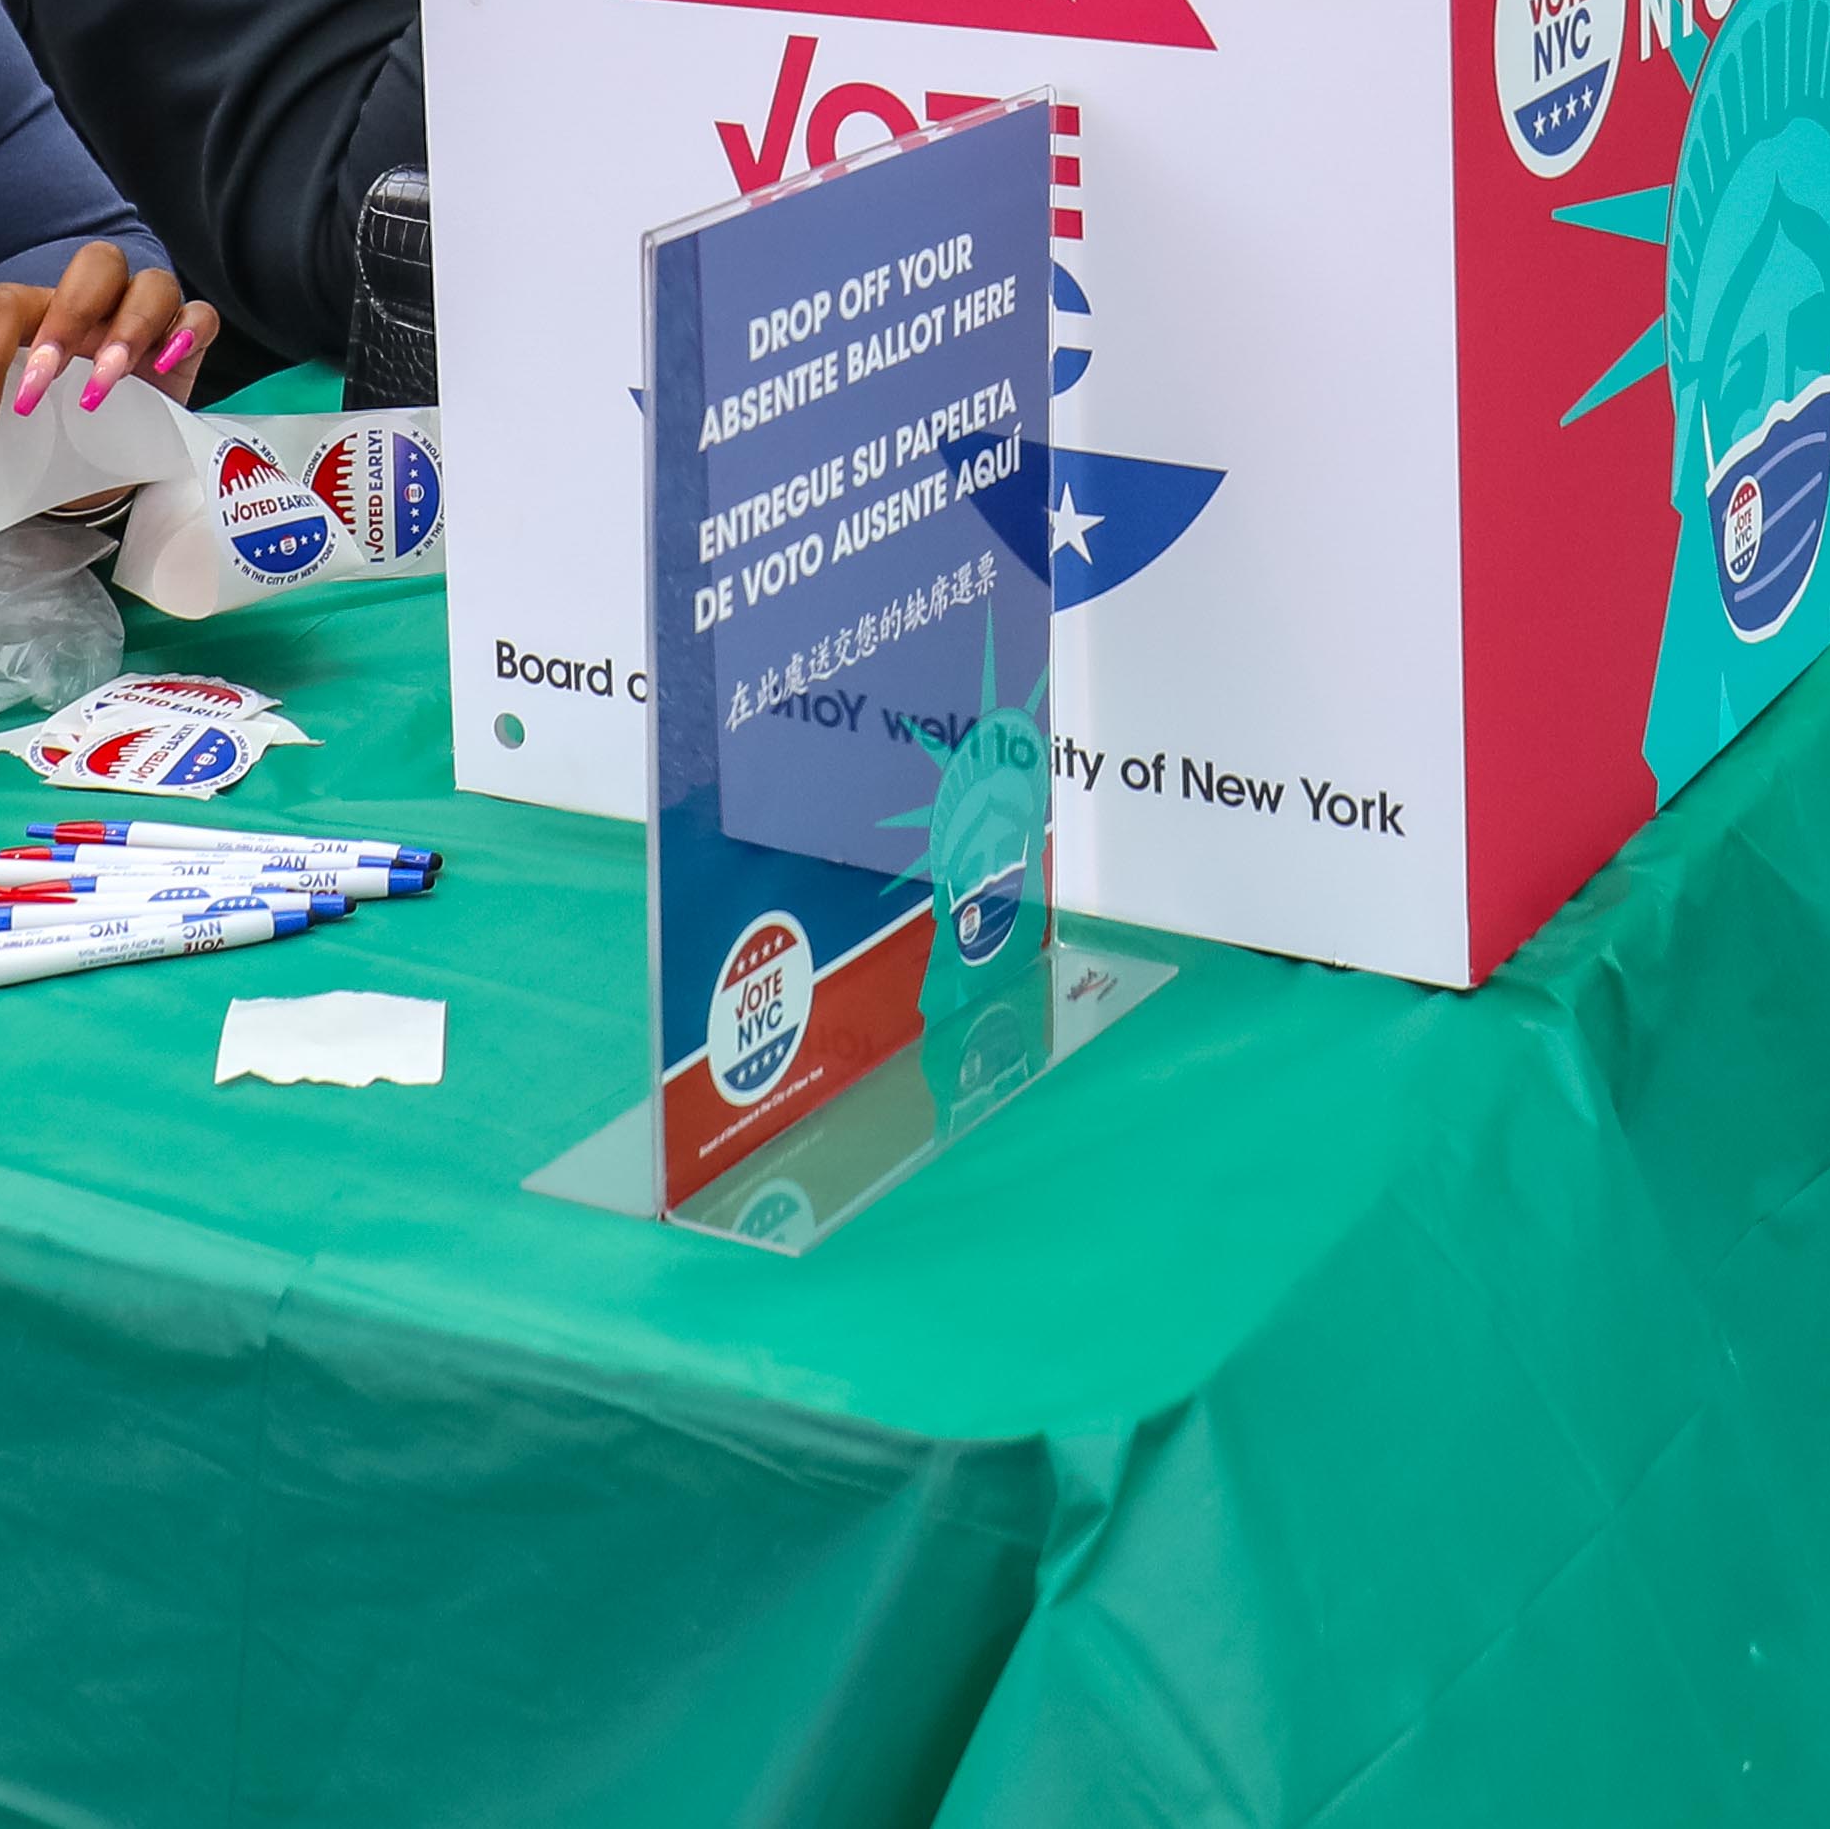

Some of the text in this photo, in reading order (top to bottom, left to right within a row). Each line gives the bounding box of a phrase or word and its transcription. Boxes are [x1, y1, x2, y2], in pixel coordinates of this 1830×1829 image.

[1533, 7, 1592, 83] NYC
[748, 233, 974, 362] DROP OFF YOUR
[698, 350, 839, 453] ABSENTEE
[846, 305, 946, 386] BALLOT
[953, 274, 1017, 338] HERE
[303, 452, 321, 488] CTIONS
[368, 430, 383, 492] EARLY!
[699, 378, 1018, 564] ENTREGUE SU PAPELETA
[222, 510, 229, 527] I
[230, 498, 278, 524] VOTED
[365, 495, 385, 555] VOTED
[694, 421, 1023, 634] DE VOTO AUSENTE AQUÍ
[241, 564, 251, 577] IN
[251, 570, 265, 583] THE
[266, 576, 286, 586] CITY
[495, 639, 648, 704] Board o
[170, 702, 233, 719] EARLY!
[1054, 735, 1406, 837] ity of New York
[299, 872, 337, 888] NYC
[89, 921, 129, 938] NYC
[182, 921, 222, 940] NYC
[735, 967, 784, 1020] VOTE
[737, 1000, 784, 1054] NYC
